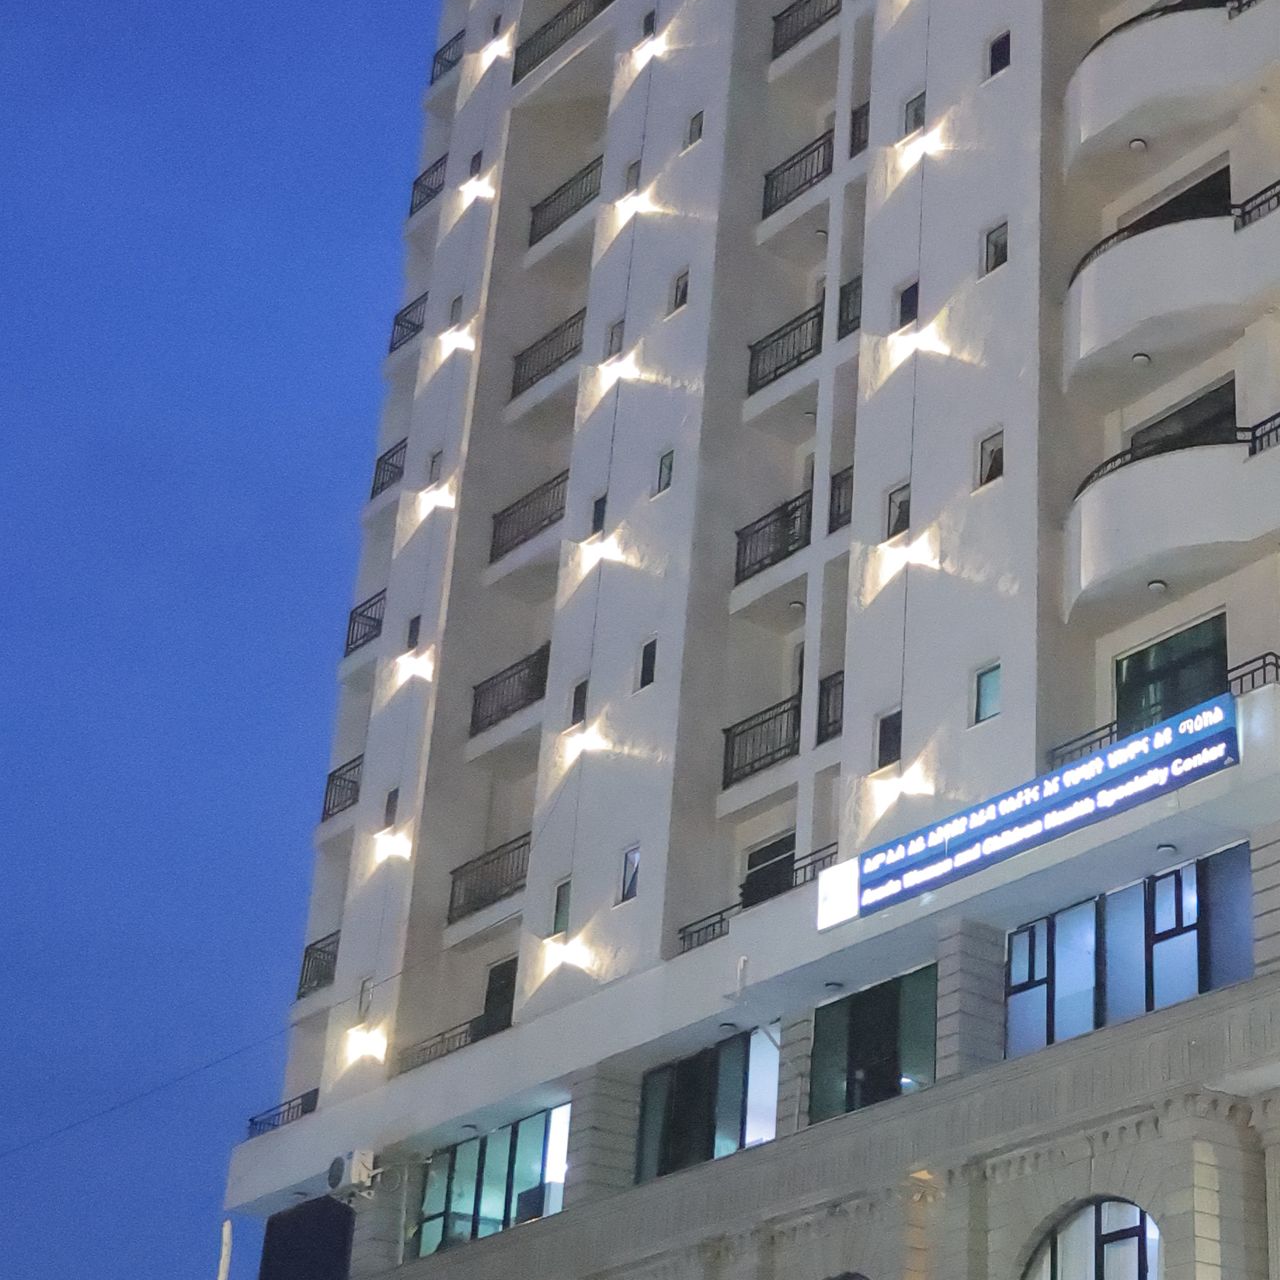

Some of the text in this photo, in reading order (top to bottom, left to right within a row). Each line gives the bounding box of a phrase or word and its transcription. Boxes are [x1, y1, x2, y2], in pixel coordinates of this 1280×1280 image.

[1179, 706, 1224, 734] ማዕከል
[902, 858, 953, 888] Women
[953, 843, 982, 867] and
[982, 820, 1043, 855] Children
[1043, 797, 1096, 830] Health
[1171, 743, 1226, 776] Center
